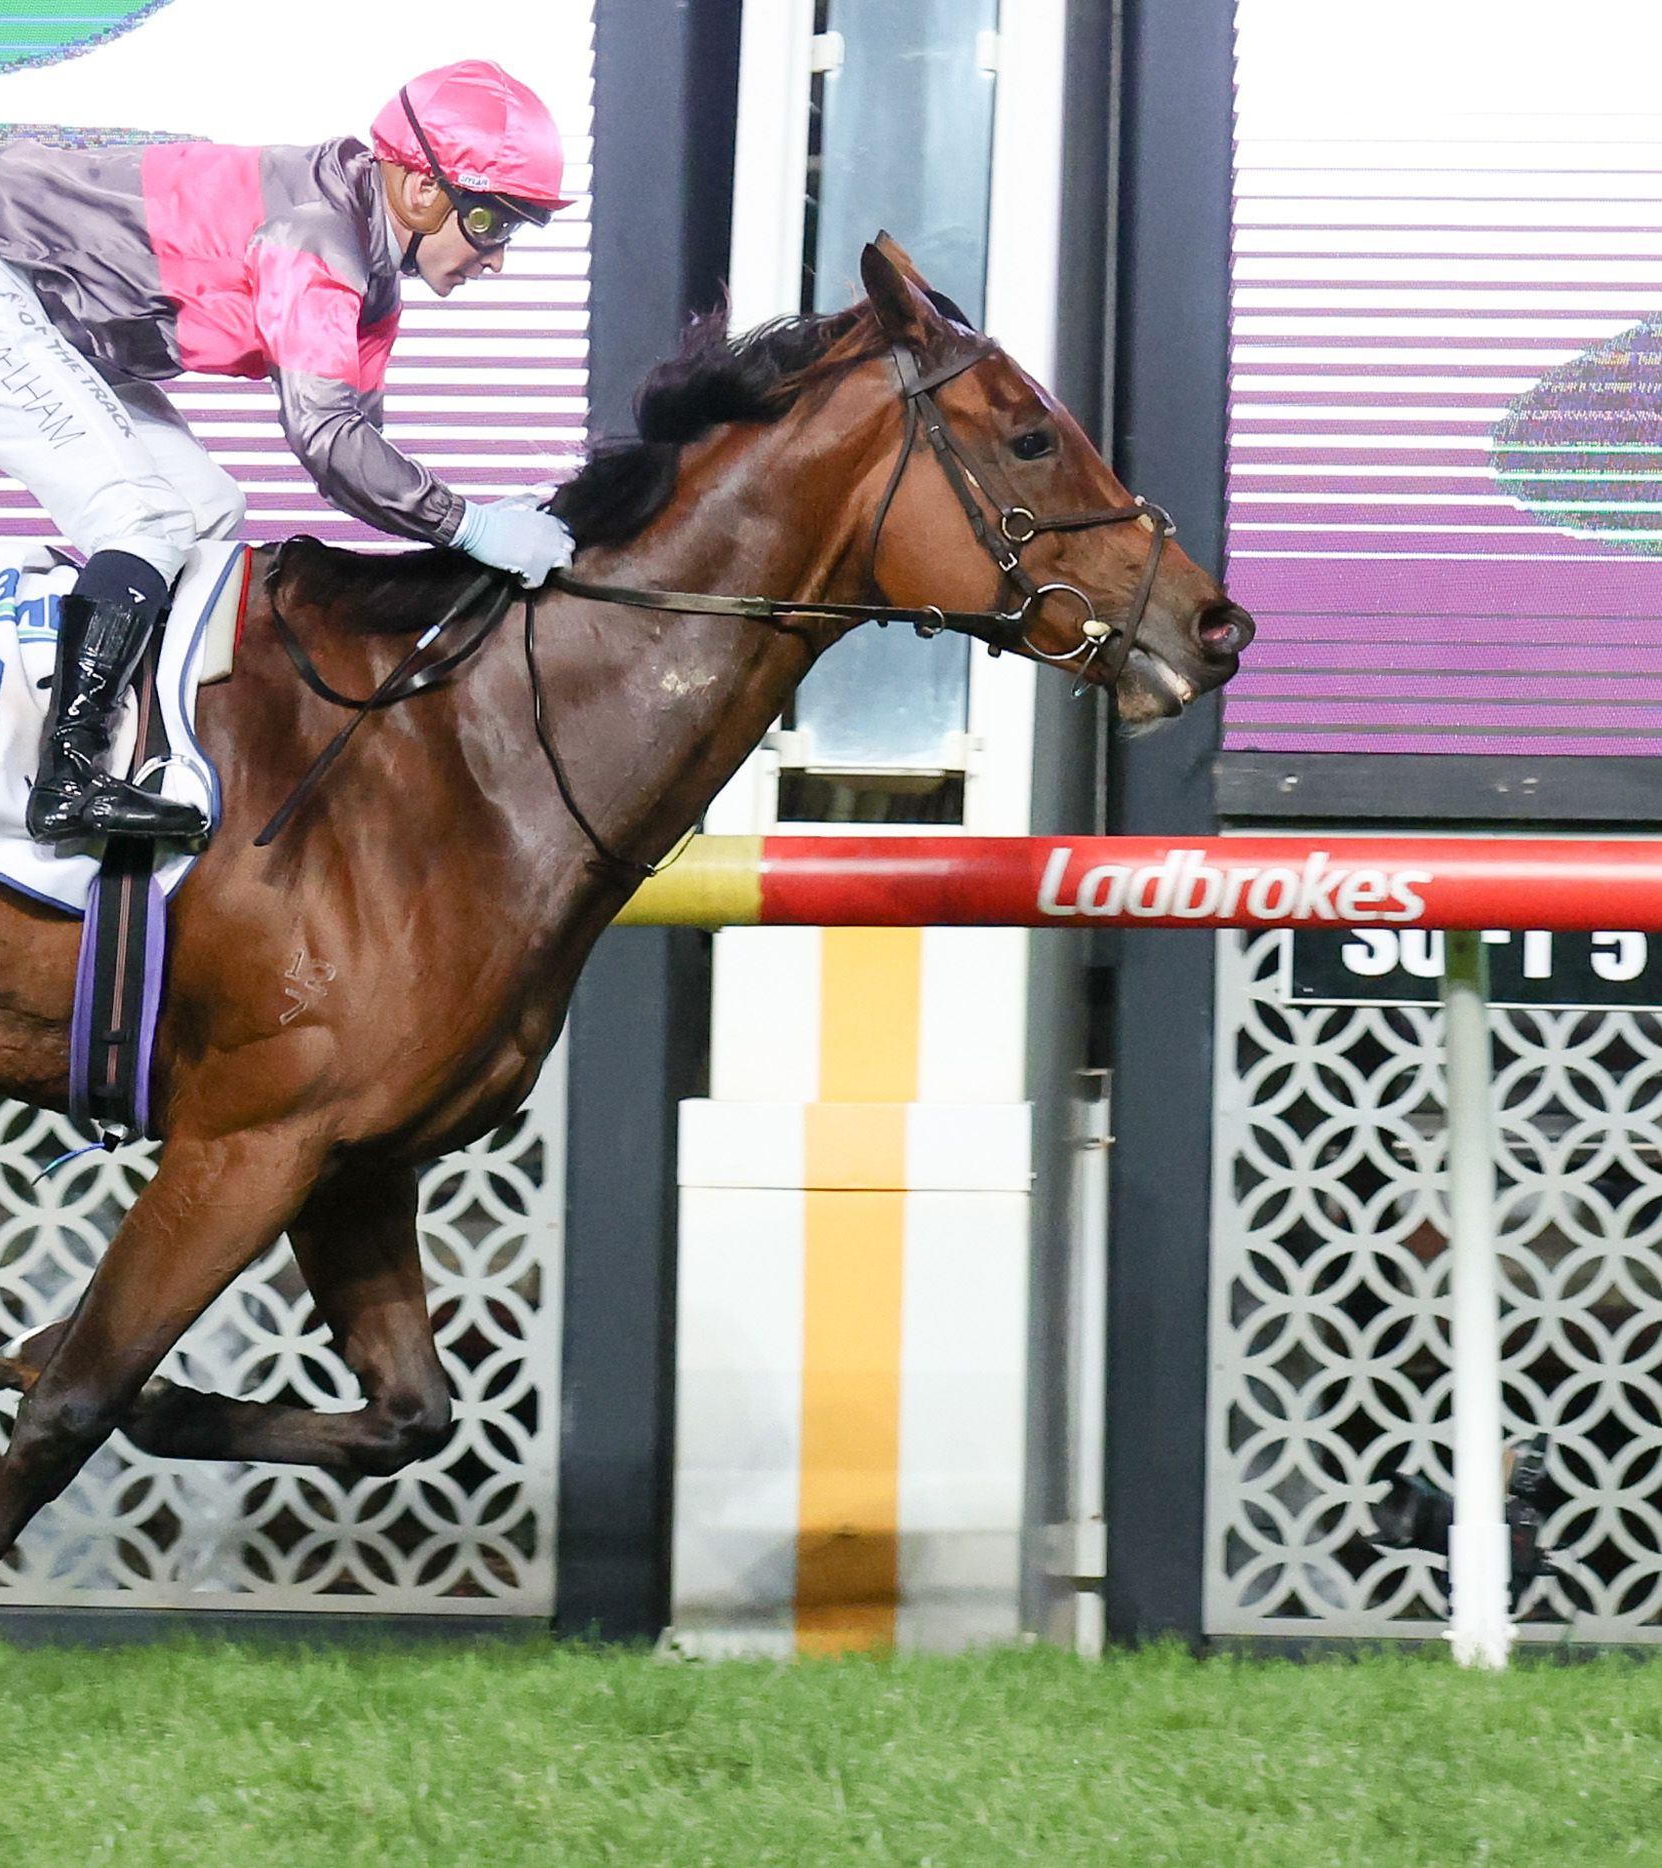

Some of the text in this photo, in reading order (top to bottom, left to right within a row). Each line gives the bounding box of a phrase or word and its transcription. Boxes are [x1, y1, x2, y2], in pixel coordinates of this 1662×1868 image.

[46, 339, 86, 373] THE
[81, 376, 137, 439] TRACK
[1039, 846, 1435, 922] Ladbrokes
